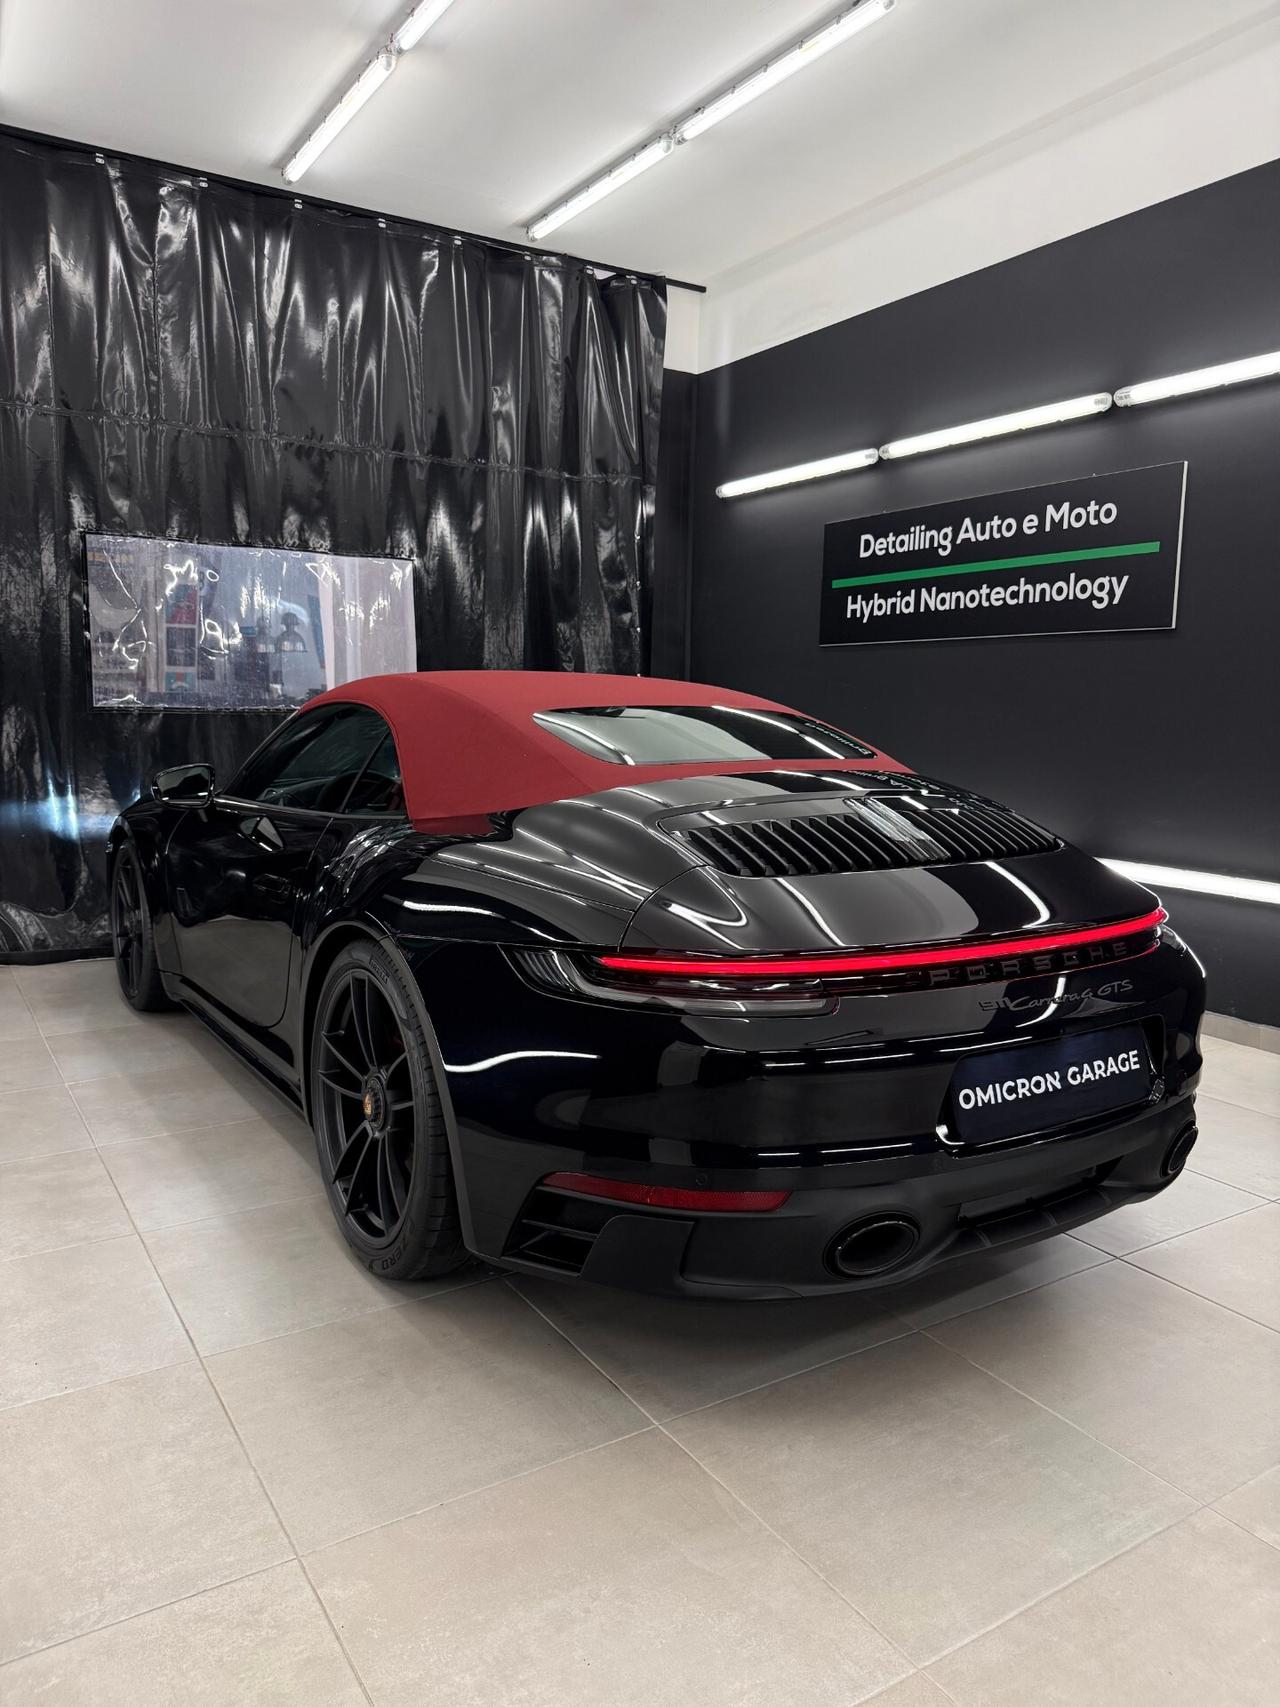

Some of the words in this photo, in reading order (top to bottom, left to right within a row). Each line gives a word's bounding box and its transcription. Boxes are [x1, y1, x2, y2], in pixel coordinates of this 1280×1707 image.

[859, 525, 952, 557] Detailing
[956, 516, 1016, 544] Auto
[1022, 514, 1039, 535] e
[1045, 500, 1118, 532] Moto
[846, 590, 915, 623] Hybrid
[920, 573, 1129, 611] Nanotechnology
[930, 942, 1126, 985] PORSCHE
[1097, 979, 1134, 996] GTS
[958, 1071, 1062, 1110] OMICRON
[1067, 1050, 1140, 1086] GARAGE
